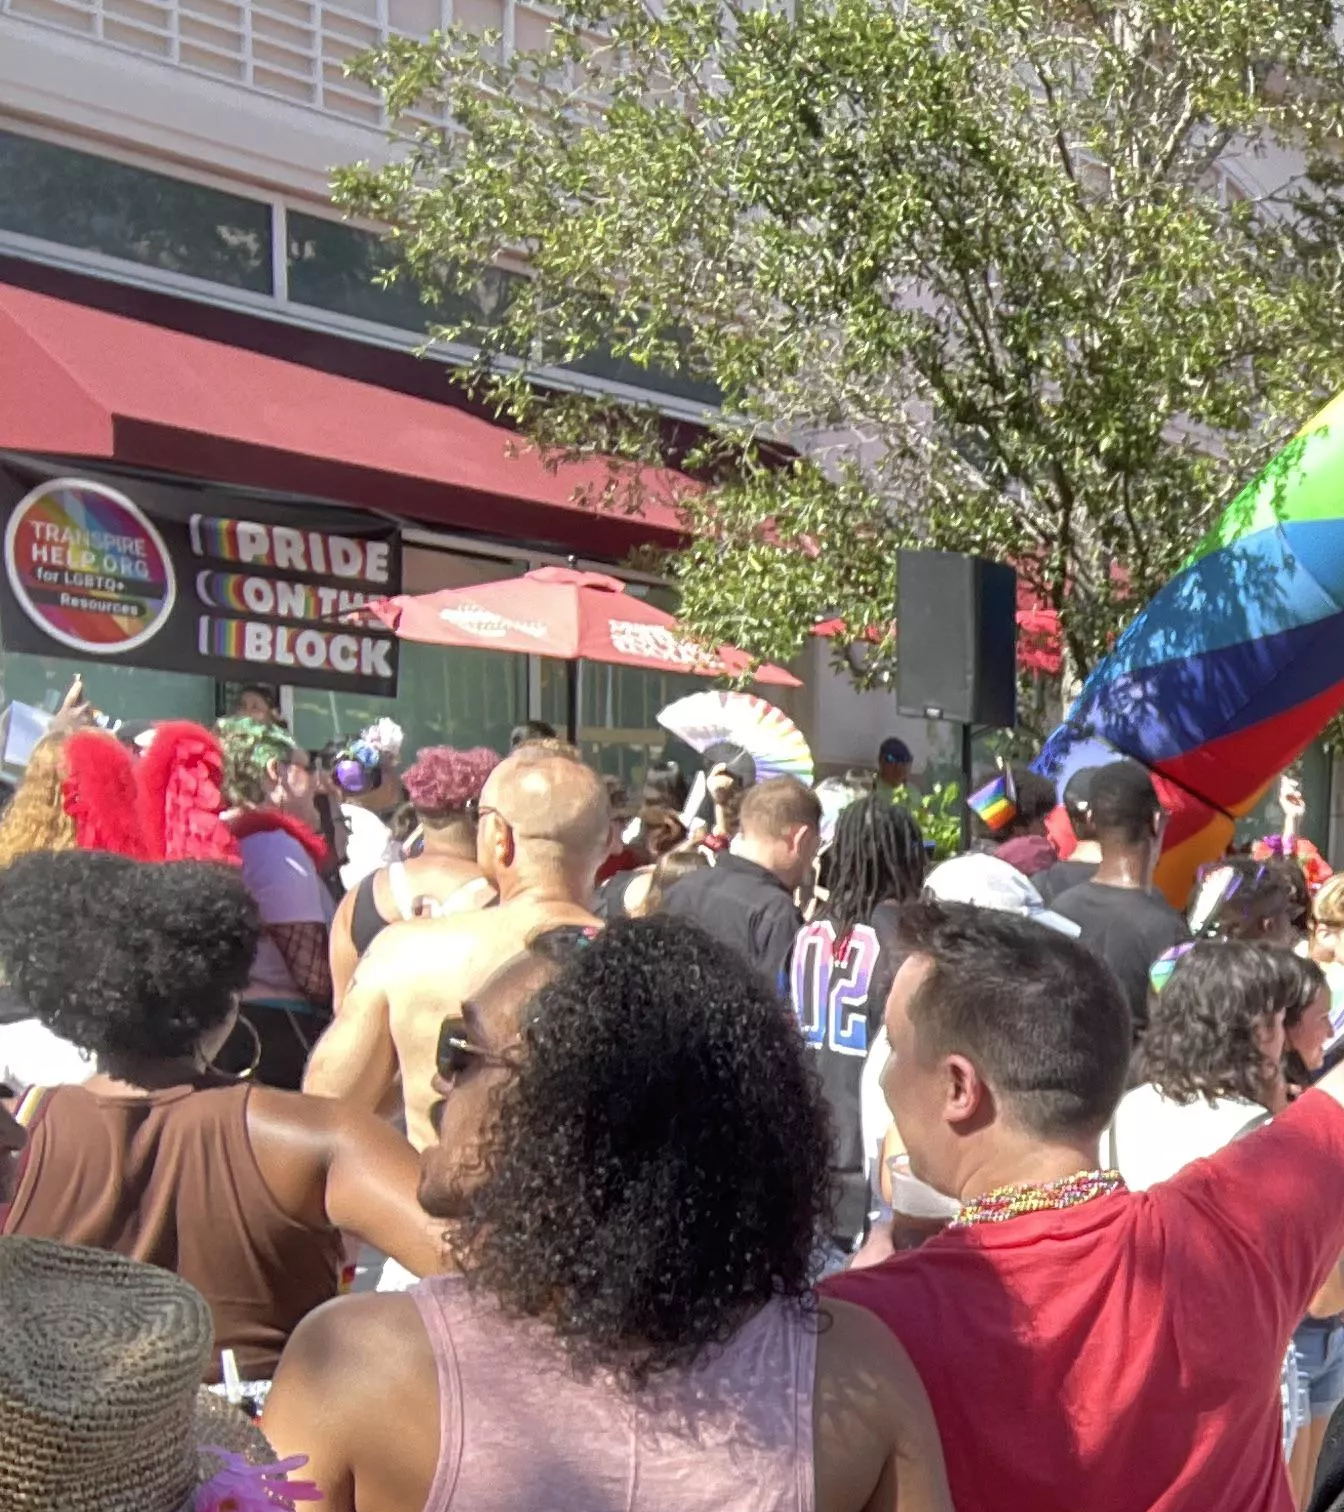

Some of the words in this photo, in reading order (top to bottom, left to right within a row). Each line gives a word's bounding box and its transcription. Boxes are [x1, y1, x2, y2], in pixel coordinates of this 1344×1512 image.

[30, 519, 147, 557] TRANSPIRE
[236, 520, 389, 584] PRIDE
[37, 566, 59, 583] for
[65, 571, 125, 591] LGBTQ+
[242, 577, 305, 618] ON
[60, 592, 138, 616] Resources
[245, 621, 392, 678] BLOCK
[790, 920, 880, 1058] 02
